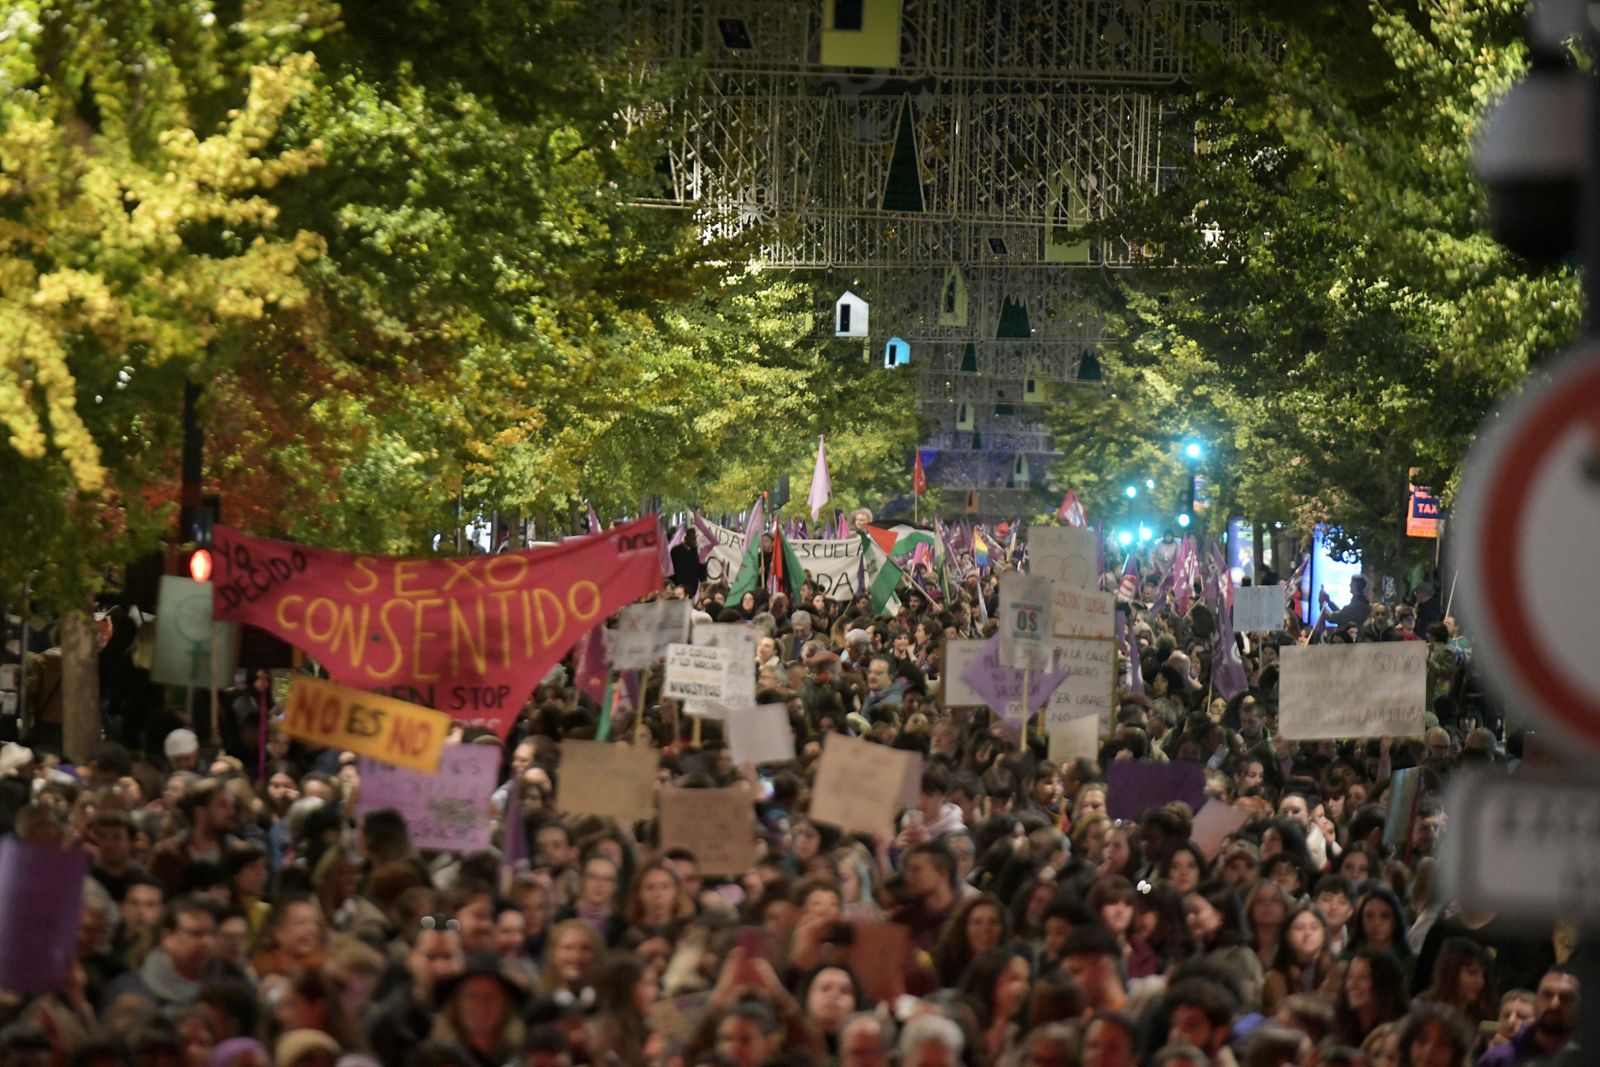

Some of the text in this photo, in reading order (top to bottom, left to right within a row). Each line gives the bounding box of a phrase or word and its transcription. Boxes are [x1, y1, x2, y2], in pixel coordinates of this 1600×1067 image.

[213, 538, 250, 576] YO
[218, 549, 307, 612] DECIDO
[345, 554, 529, 598] SEXO
[276, 579, 601, 680] CONSENTIDO
[287, 684, 434, 758] NO ES NO
[449, 684, 512, 711] STOP
